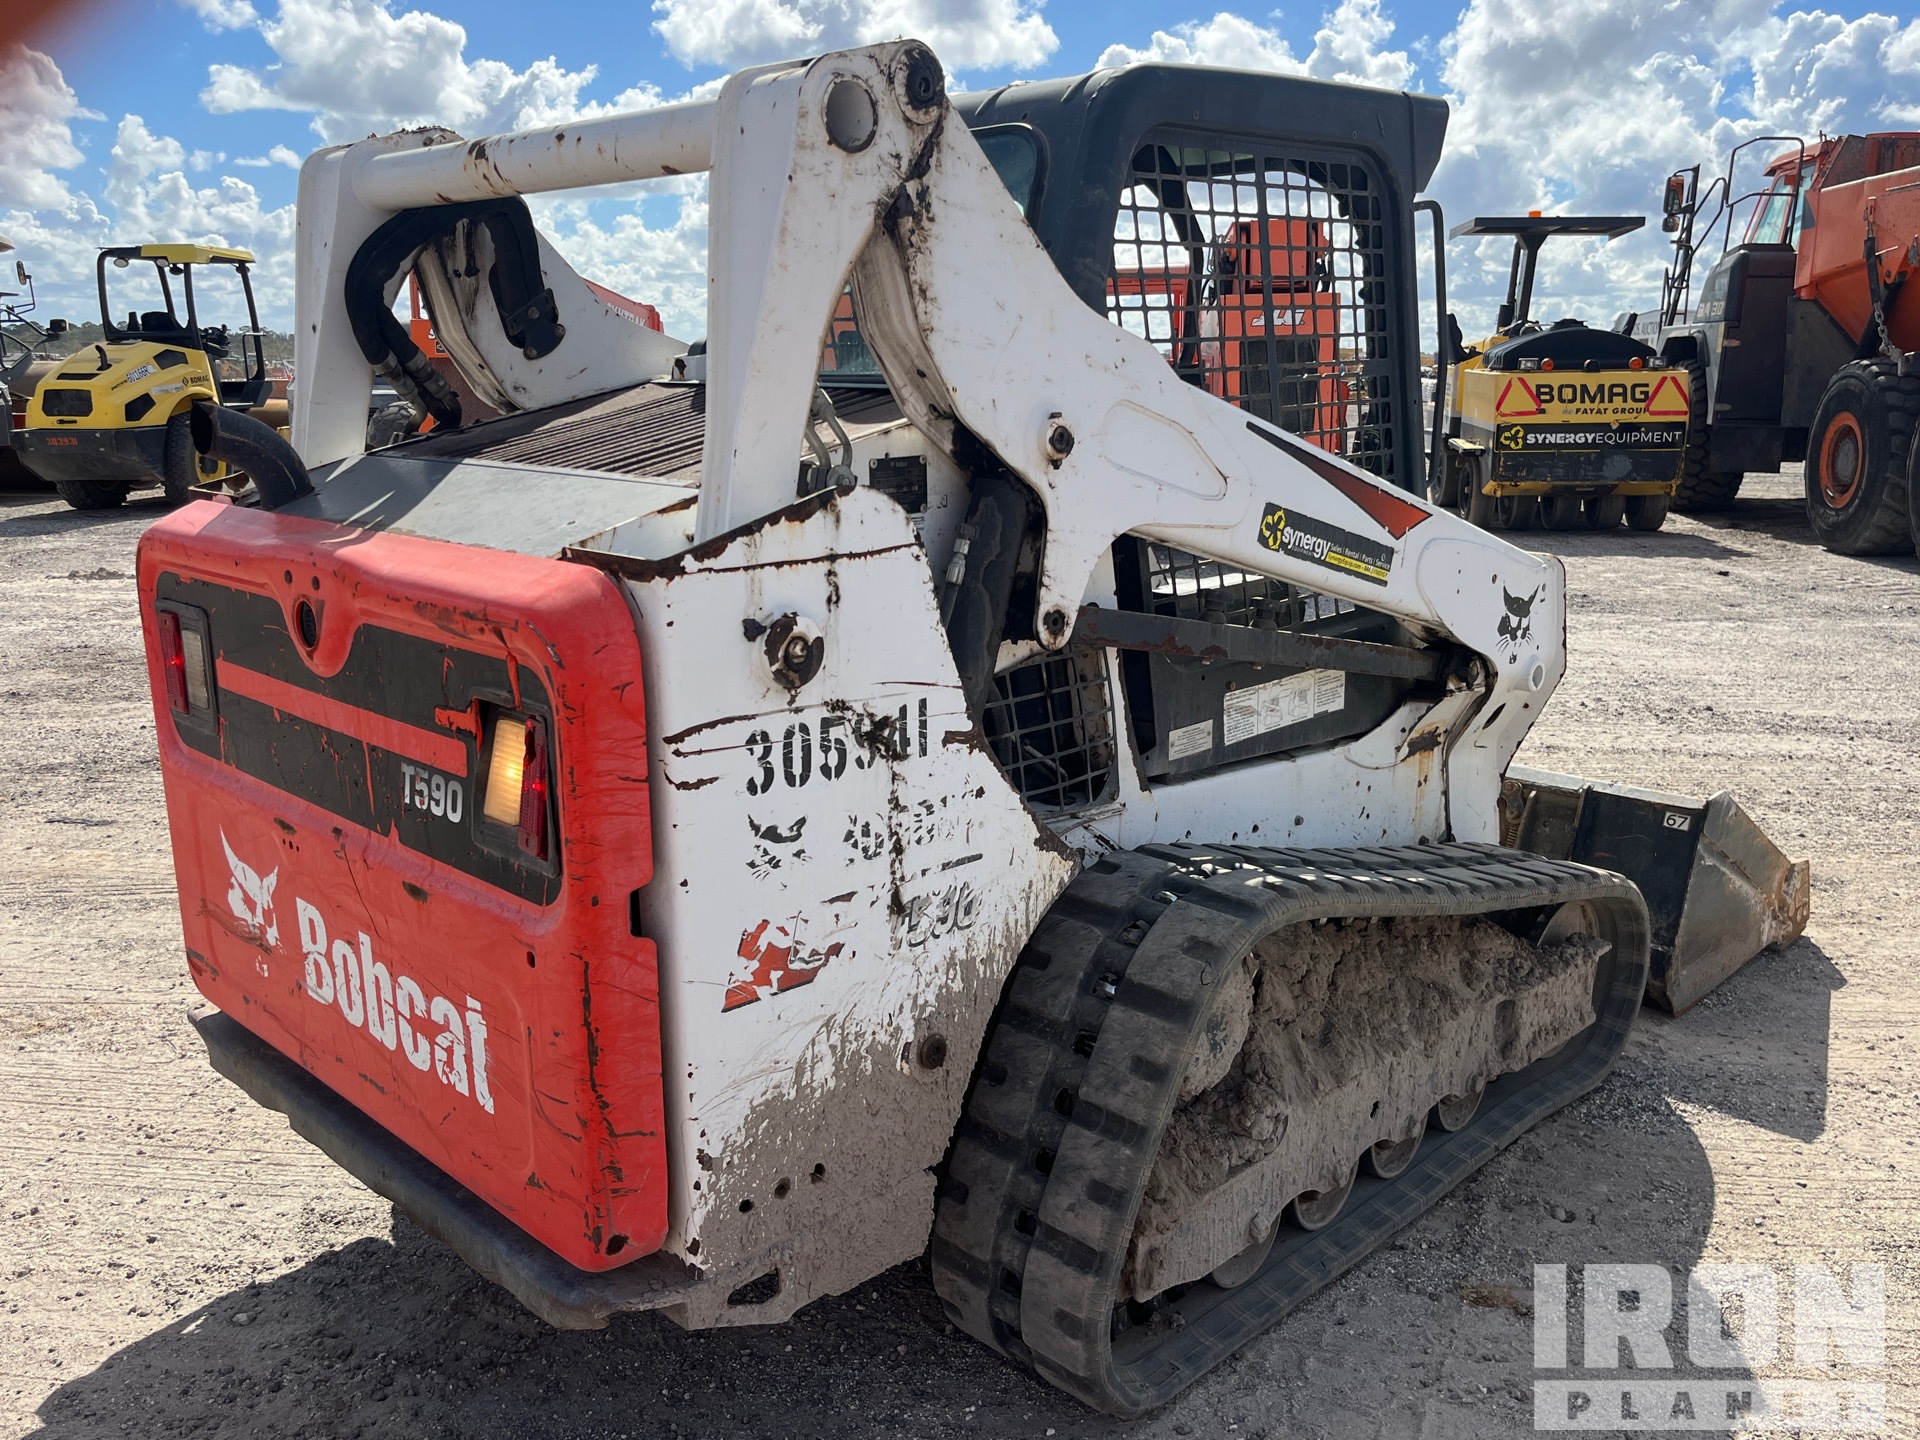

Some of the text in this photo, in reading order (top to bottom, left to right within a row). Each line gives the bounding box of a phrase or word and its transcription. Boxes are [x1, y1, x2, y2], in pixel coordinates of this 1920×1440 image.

[189, 374, 210, 385] BOMAG
[1535, 383, 1650, 404] BOMAG
[1575, 407, 1608, 415] FAYAT
[1612, 407, 1650, 415] GROUP
[1282, 526, 1331, 560] synergy
[1345, 548, 1360, 560] Rental
[1362, 554, 1373, 565] Parts
[401, 761, 463, 823] T590
[1665, 814, 1689, 828] 67
[296, 897, 495, 1114] Bobcat
